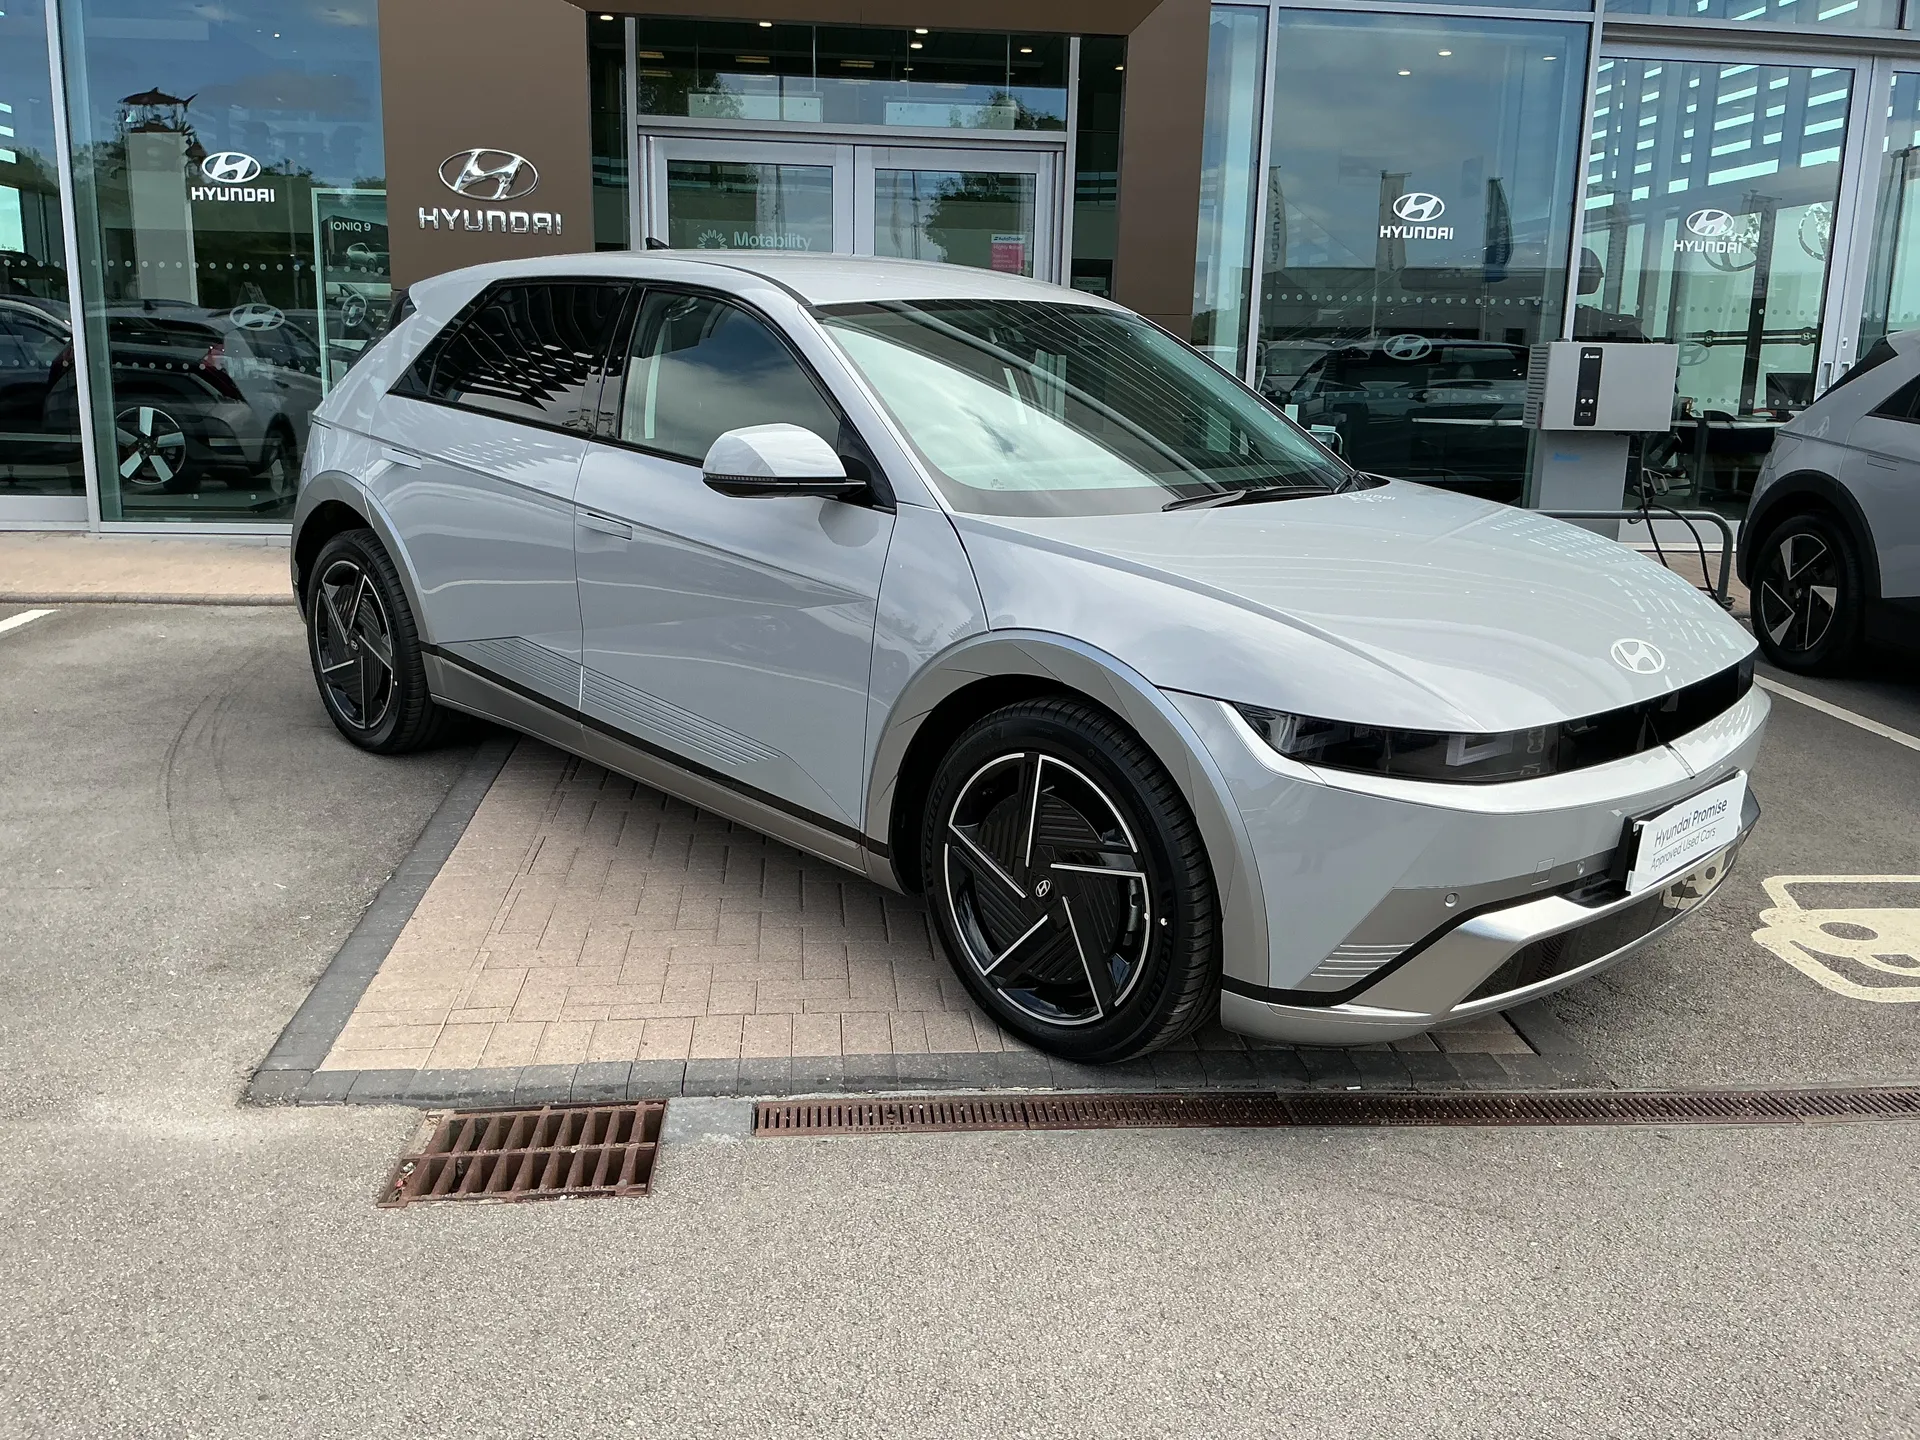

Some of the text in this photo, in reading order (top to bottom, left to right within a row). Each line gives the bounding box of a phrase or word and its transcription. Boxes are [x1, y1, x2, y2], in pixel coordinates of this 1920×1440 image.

[191, 186, 275, 203] HYUNDAI
[330, 221, 372, 233] IONIQ 9
[418, 206, 562, 235] HYUNDAI
[733, 231, 812, 251] Motability
[1379, 225, 1454, 240] HYUNDAI
[1673, 239, 1742, 254] HYUNDAI
[1655, 799, 1728, 848] Hyundai Promise
[1650, 827, 1716, 871] Approved Used Cars
